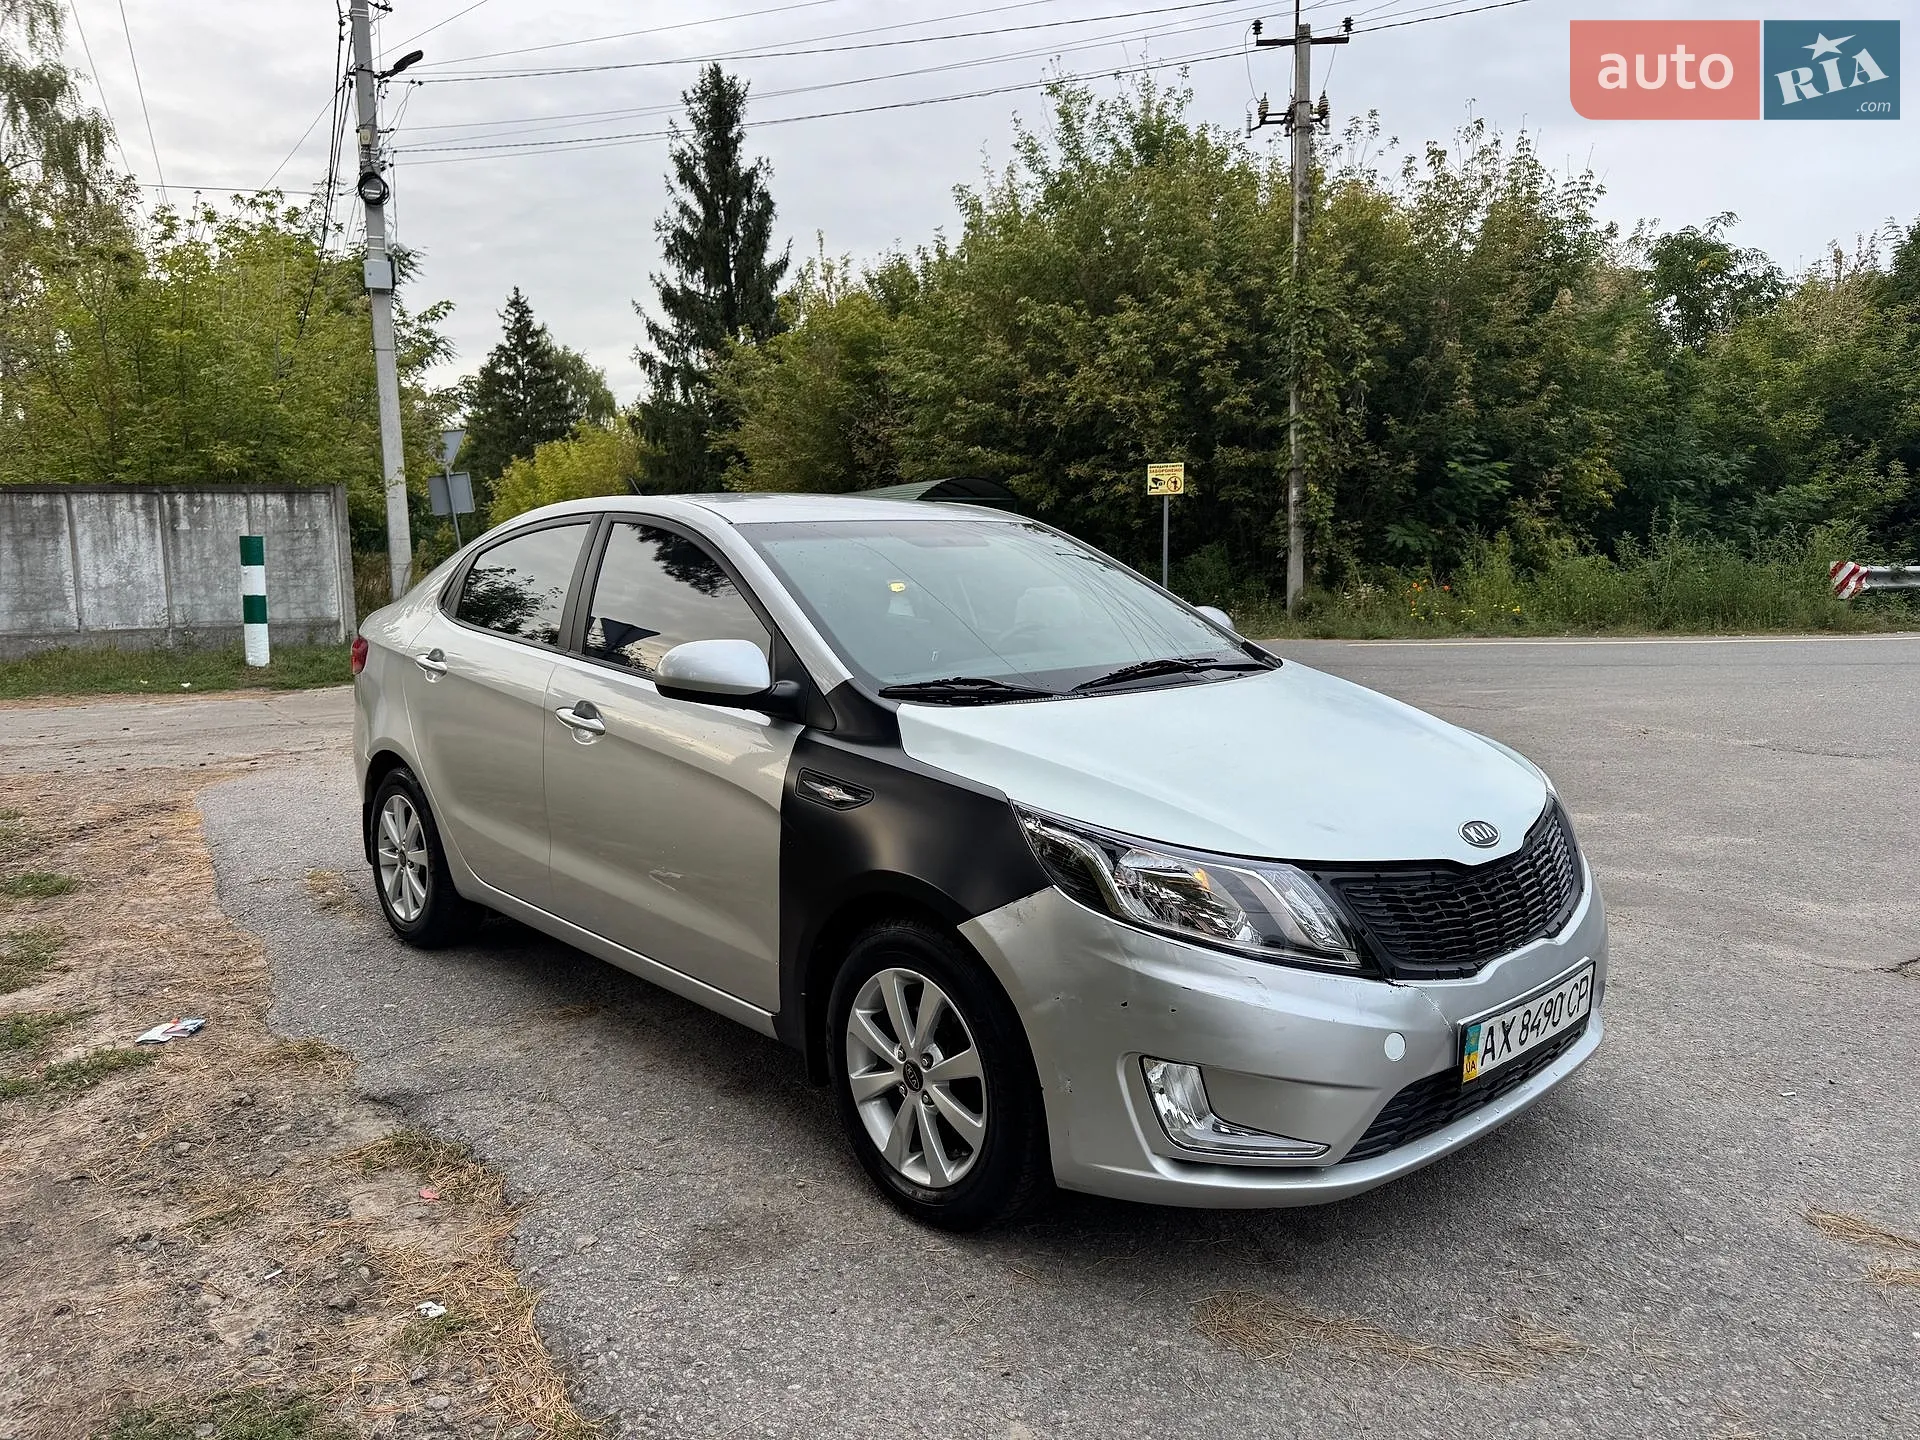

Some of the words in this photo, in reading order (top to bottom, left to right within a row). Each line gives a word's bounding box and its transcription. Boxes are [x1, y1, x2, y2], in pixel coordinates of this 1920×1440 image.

[1464, 823, 1498, 842] KIA
[1480, 1015, 1517, 1067] AX
[1519, 991, 1565, 1046] 8490
[1567, 975, 1589, 1018] CP
[1465, 1061, 1476, 1074] UA
[907, 1068, 917, 1087] KIA
